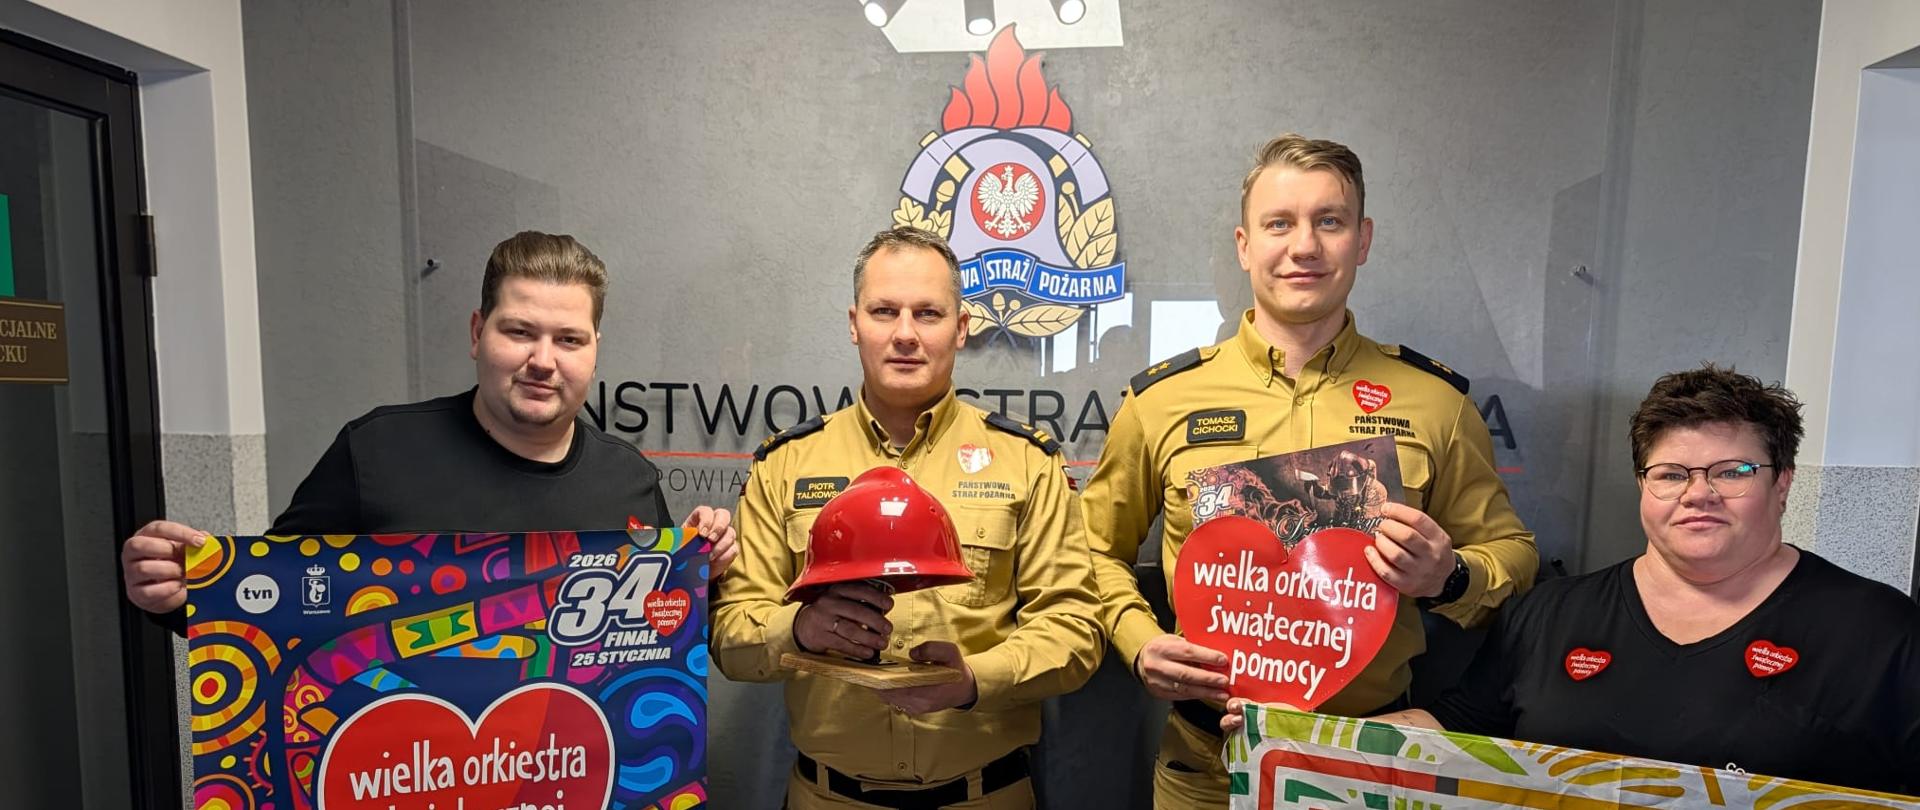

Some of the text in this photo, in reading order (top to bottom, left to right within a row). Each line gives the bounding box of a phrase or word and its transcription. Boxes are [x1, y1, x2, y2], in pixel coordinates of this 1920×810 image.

[986, 258, 1031, 283] STRAŻ
[1039, 271, 1117, 298] POŻARNA
[1192, 424, 1238, 435] CICHOCKI
[1196, 416, 1236, 426] TOMASZ
[796, 490, 840, 500] TALKOWS
[808, 482, 835, 491] PIOTR
[1197, 484, 1234, 517] 34
[569, 553, 618, 568] 2026
[1193, 550, 1377, 612] wielka orkiestra
[242, 587, 273, 600] tvn
[554, 560, 666, 639] 34
[604, 629, 659, 648] FINAŁ
[1207, 594, 1354, 669] świątecznej
[572, 647, 672, 667] 25 STYCZNIA
[1229, 649, 1327, 701] pomocy
[350, 733, 587, 801] wielka orkiestra
